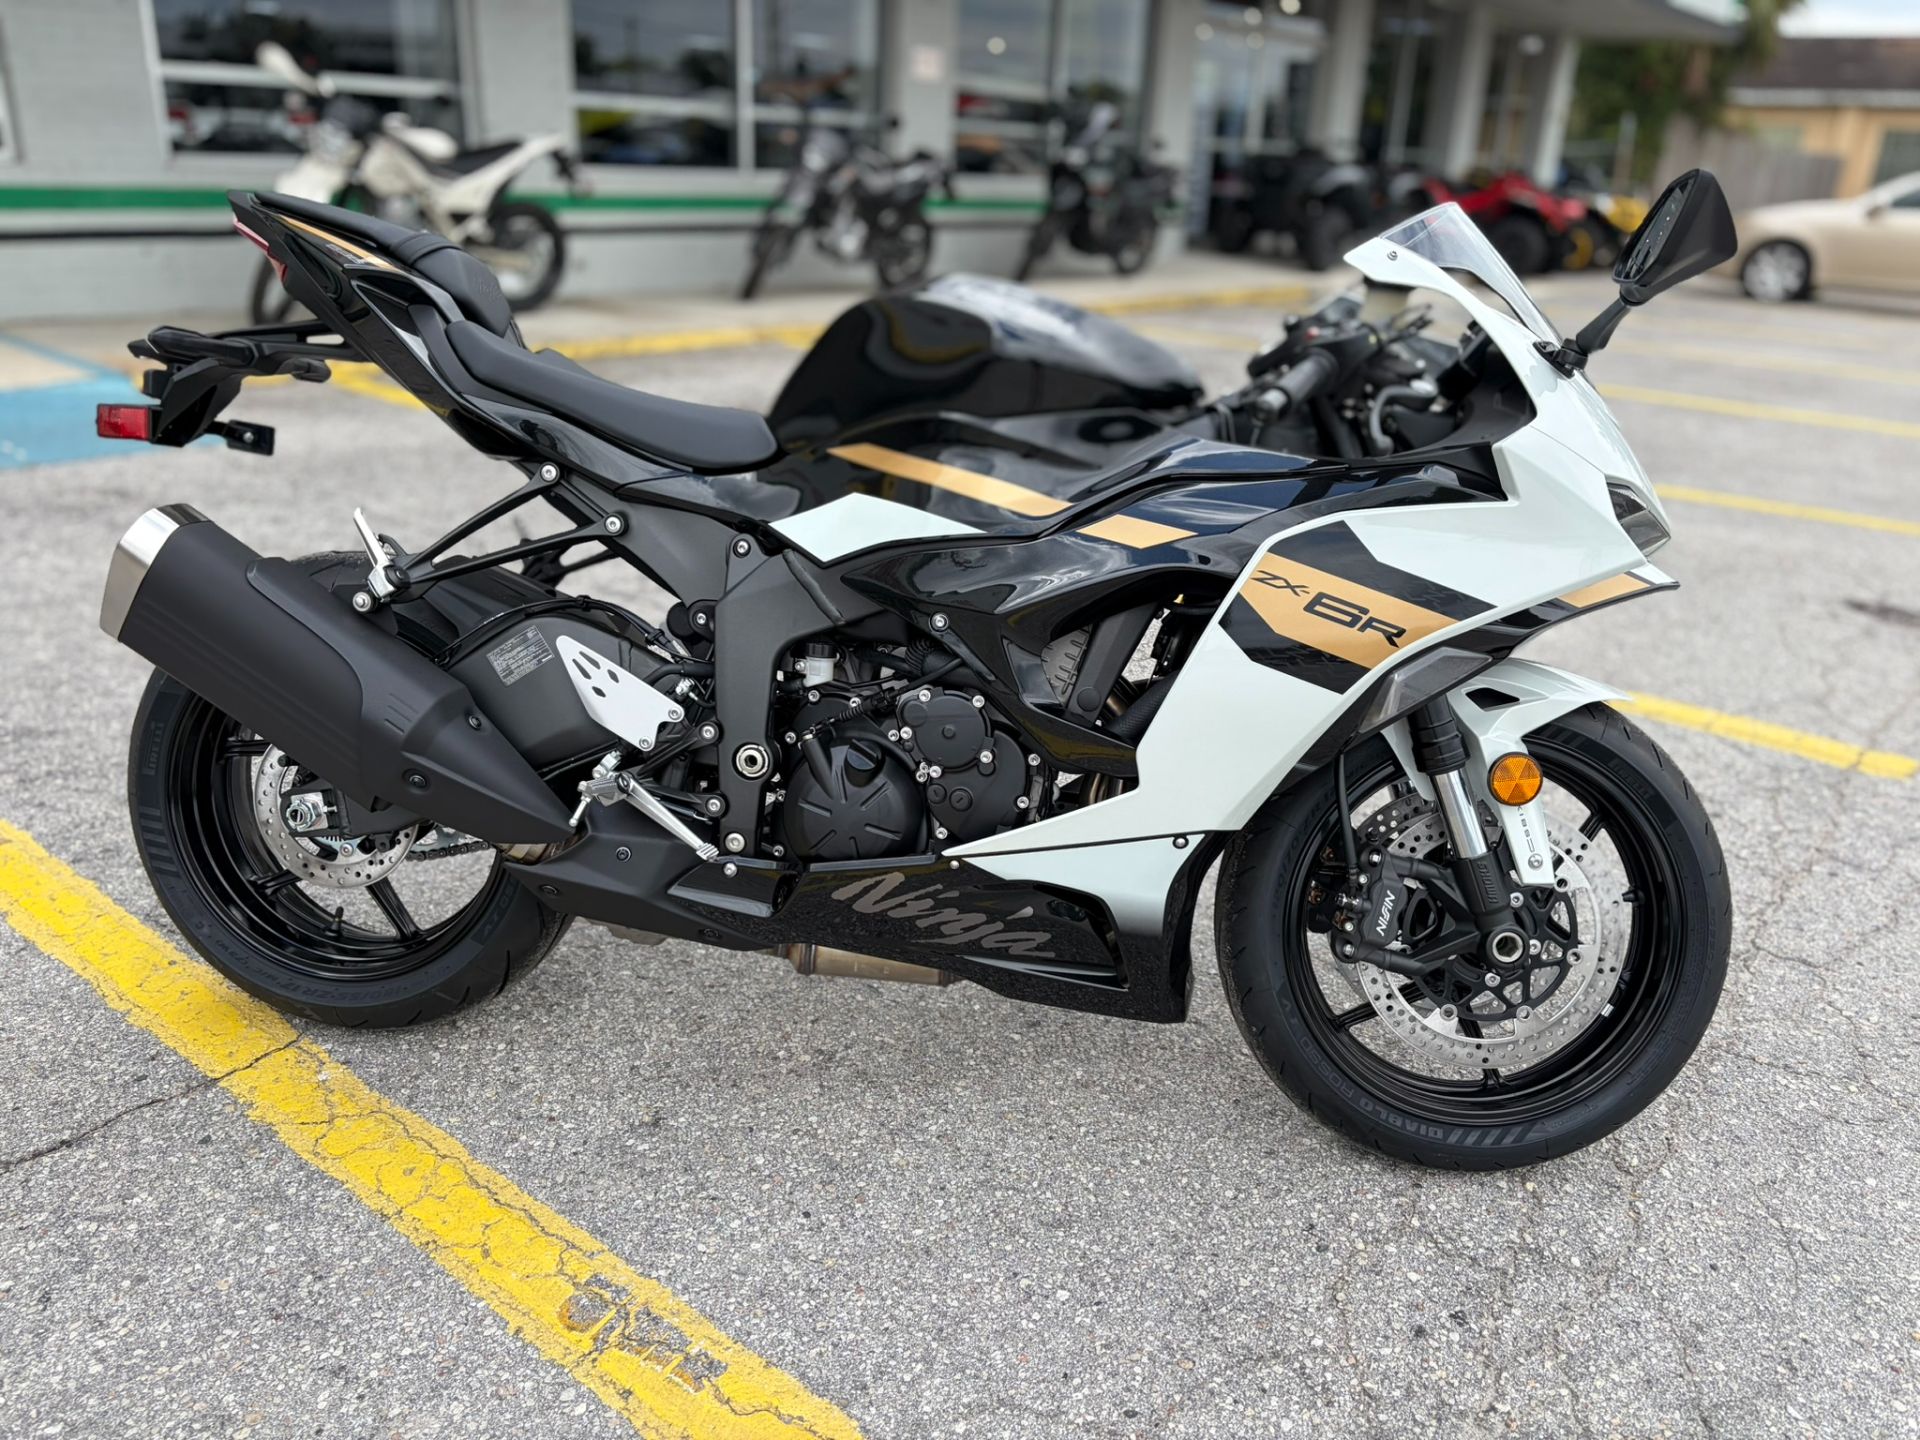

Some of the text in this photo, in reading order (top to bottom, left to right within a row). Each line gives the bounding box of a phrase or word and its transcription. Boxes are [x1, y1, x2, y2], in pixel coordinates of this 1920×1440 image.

[831, 872, 1056, 958] Ninja
[1376, 890, 1396, 937] NISSIN
[1300, 1036, 1355, 1099] ROSSO
[1359, 1099, 1444, 1140] DIABLO
